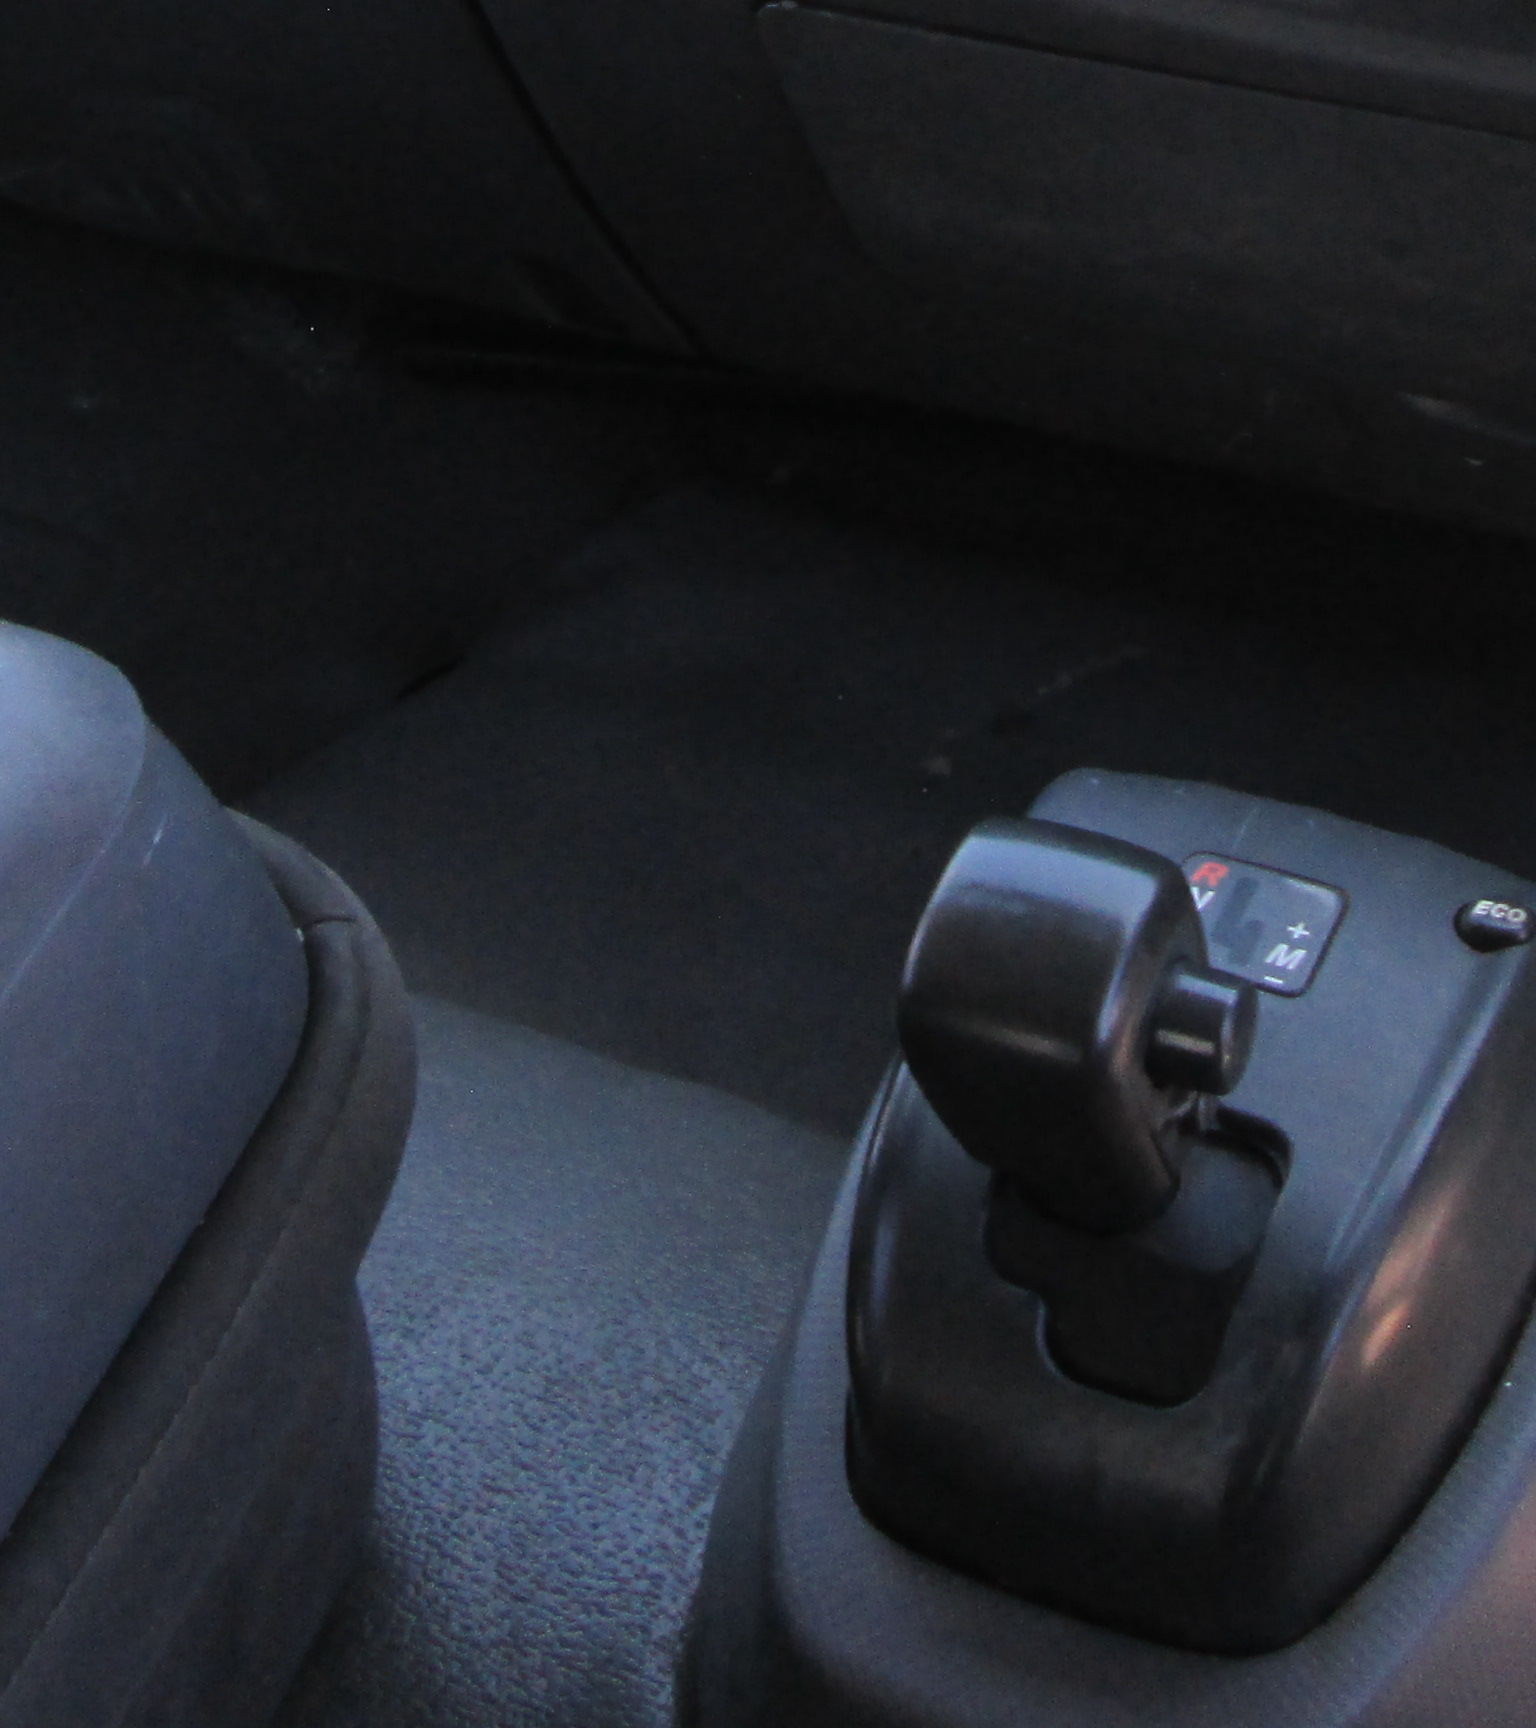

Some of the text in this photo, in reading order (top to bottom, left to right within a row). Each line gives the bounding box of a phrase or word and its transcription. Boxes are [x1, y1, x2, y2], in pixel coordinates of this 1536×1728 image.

[1190, 861, 1230, 887] R
[1471, 899, 1528, 923] ECO
[1265, 943, 1308, 971] M
